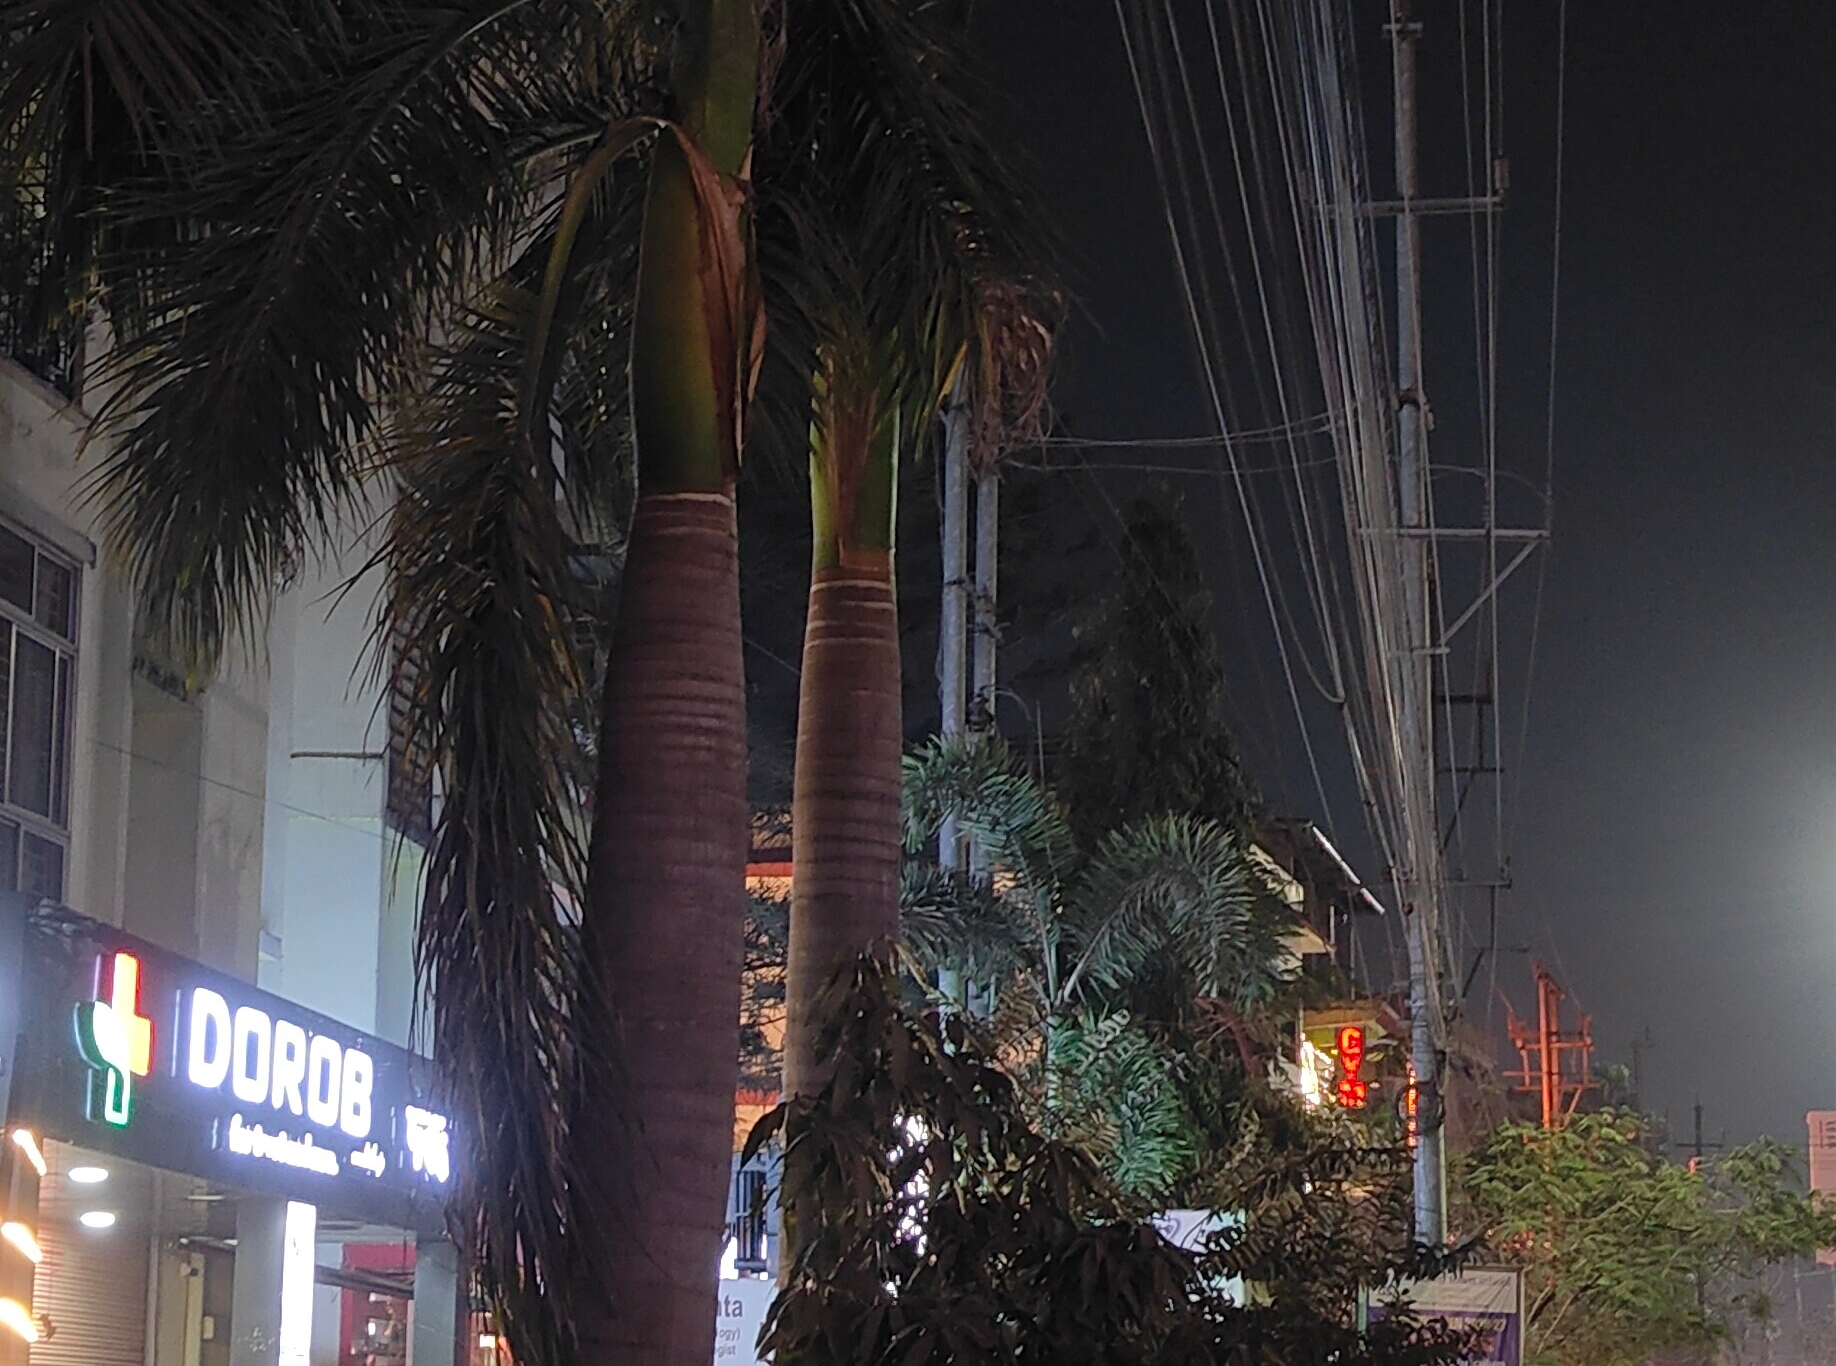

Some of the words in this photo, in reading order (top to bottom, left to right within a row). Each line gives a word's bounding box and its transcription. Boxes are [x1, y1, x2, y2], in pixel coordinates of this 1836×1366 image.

[188, 987, 374, 1137] DOROB
[718, 1327, 741, 1342] ogy)
[716, 1344, 736, 1358] gist
